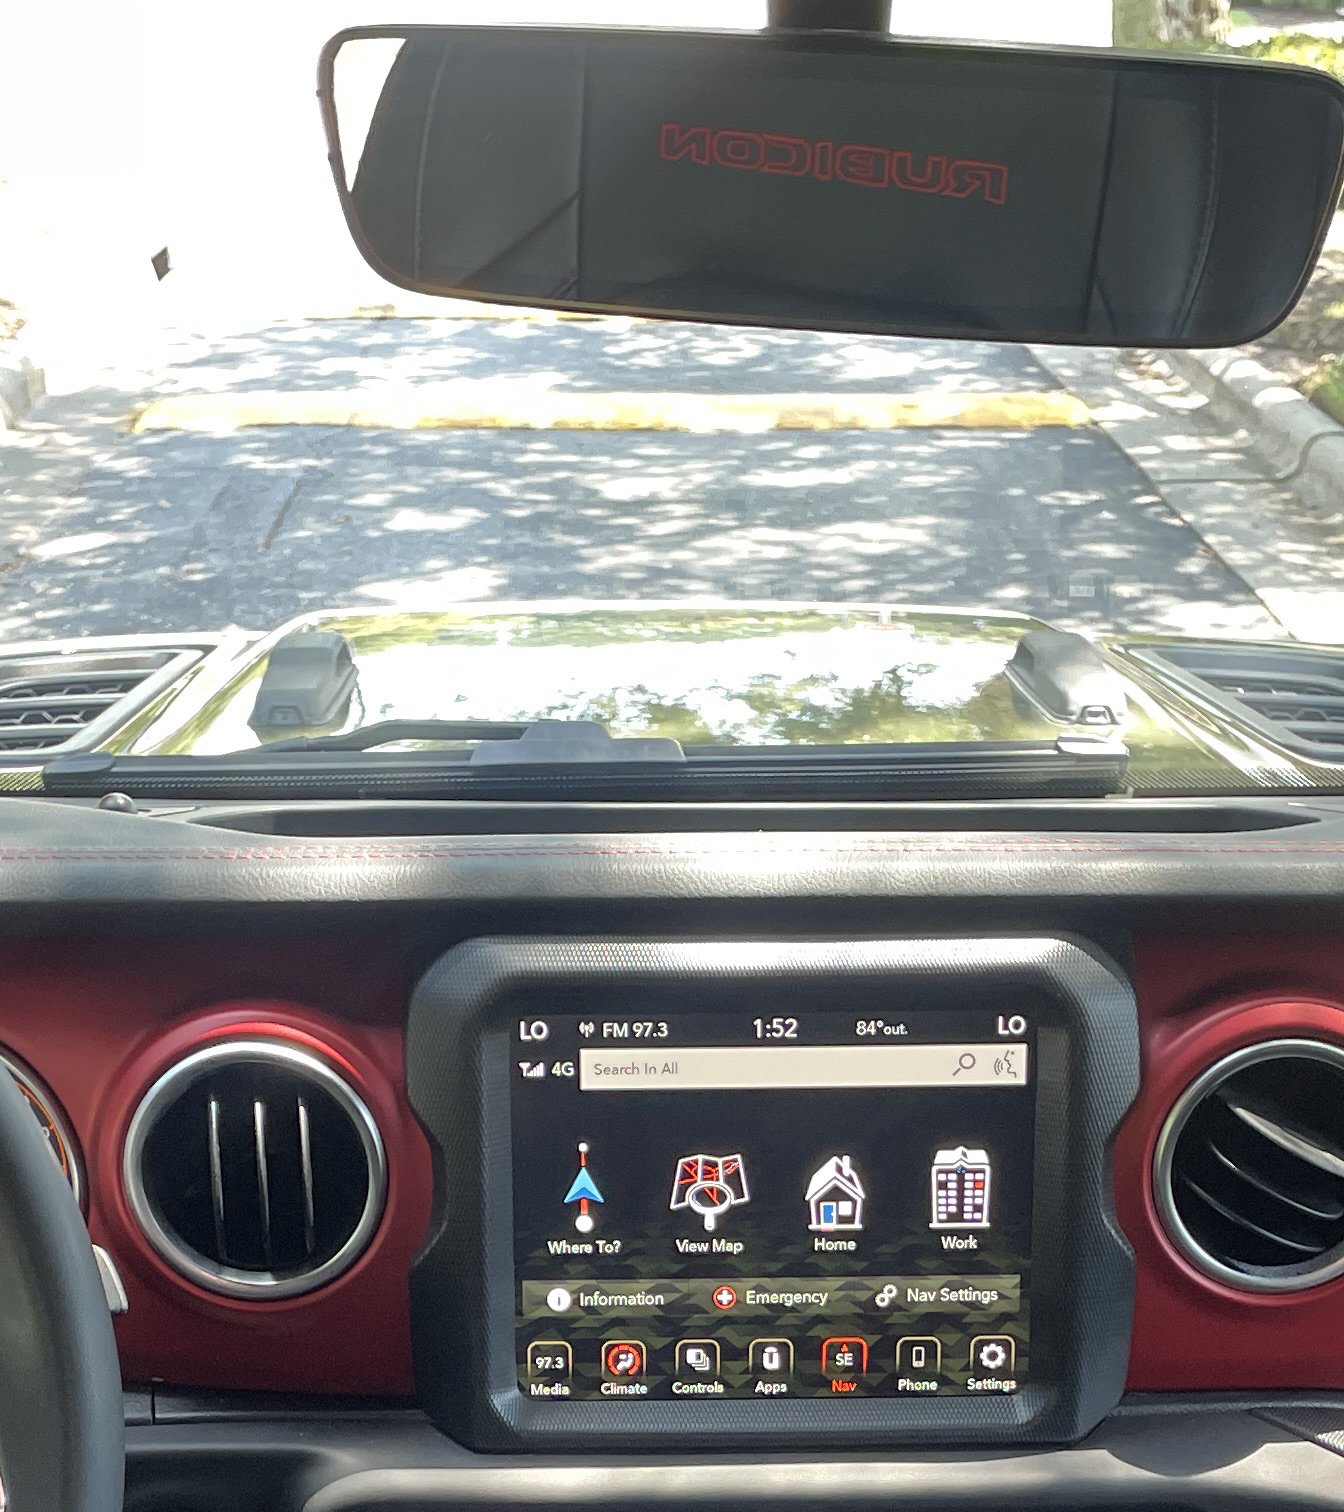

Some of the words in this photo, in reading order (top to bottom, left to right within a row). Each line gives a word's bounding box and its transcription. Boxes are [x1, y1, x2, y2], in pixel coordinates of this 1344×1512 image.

[519, 1021, 548, 1041] LO
[602, 1022, 630, 1038] FM
[633, 1021, 668, 1038] 97.3
[753, 1018, 798, 1038] 1:52
[998, 1016, 1026, 1035] LO
[552, 1061, 575, 1077] 4G
[594, 1062, 639, 1076] Search
[644, 1062, 656, 1076] In
[660, 1061, 678, 1076] All
[547, 1240, 591, 1255] Where
[595, 1239, 620, 1254] To?
[676, 1239, 708, 1254] View
[711, 1239, 743, 1257] Map
[814, 1237, 856, 1252] Home
[941, 1235, 978, 1250] Work
[579, 1290, 664, 1306] Information
[746, 1289, 828, 1308] Emergency
[907, 1287, 931, 1303] Nav
[935, 1286, 998, 1305] Settings
[535, 1355, 564, 1370] 97.3
[835, 1352, 854, 1367] SE
[530, 1382, 570, 1397] Media
[600, 1380, 648, 1395] Climate
[672, 1380, 724, 1395] Controls
[755, 1380, 787, 1397] Apps
[831, 1378, 857, 1393] Nav
[898, 1377, 938, 1392] Phone
[967, 1376, 1016, 1394] Settings
